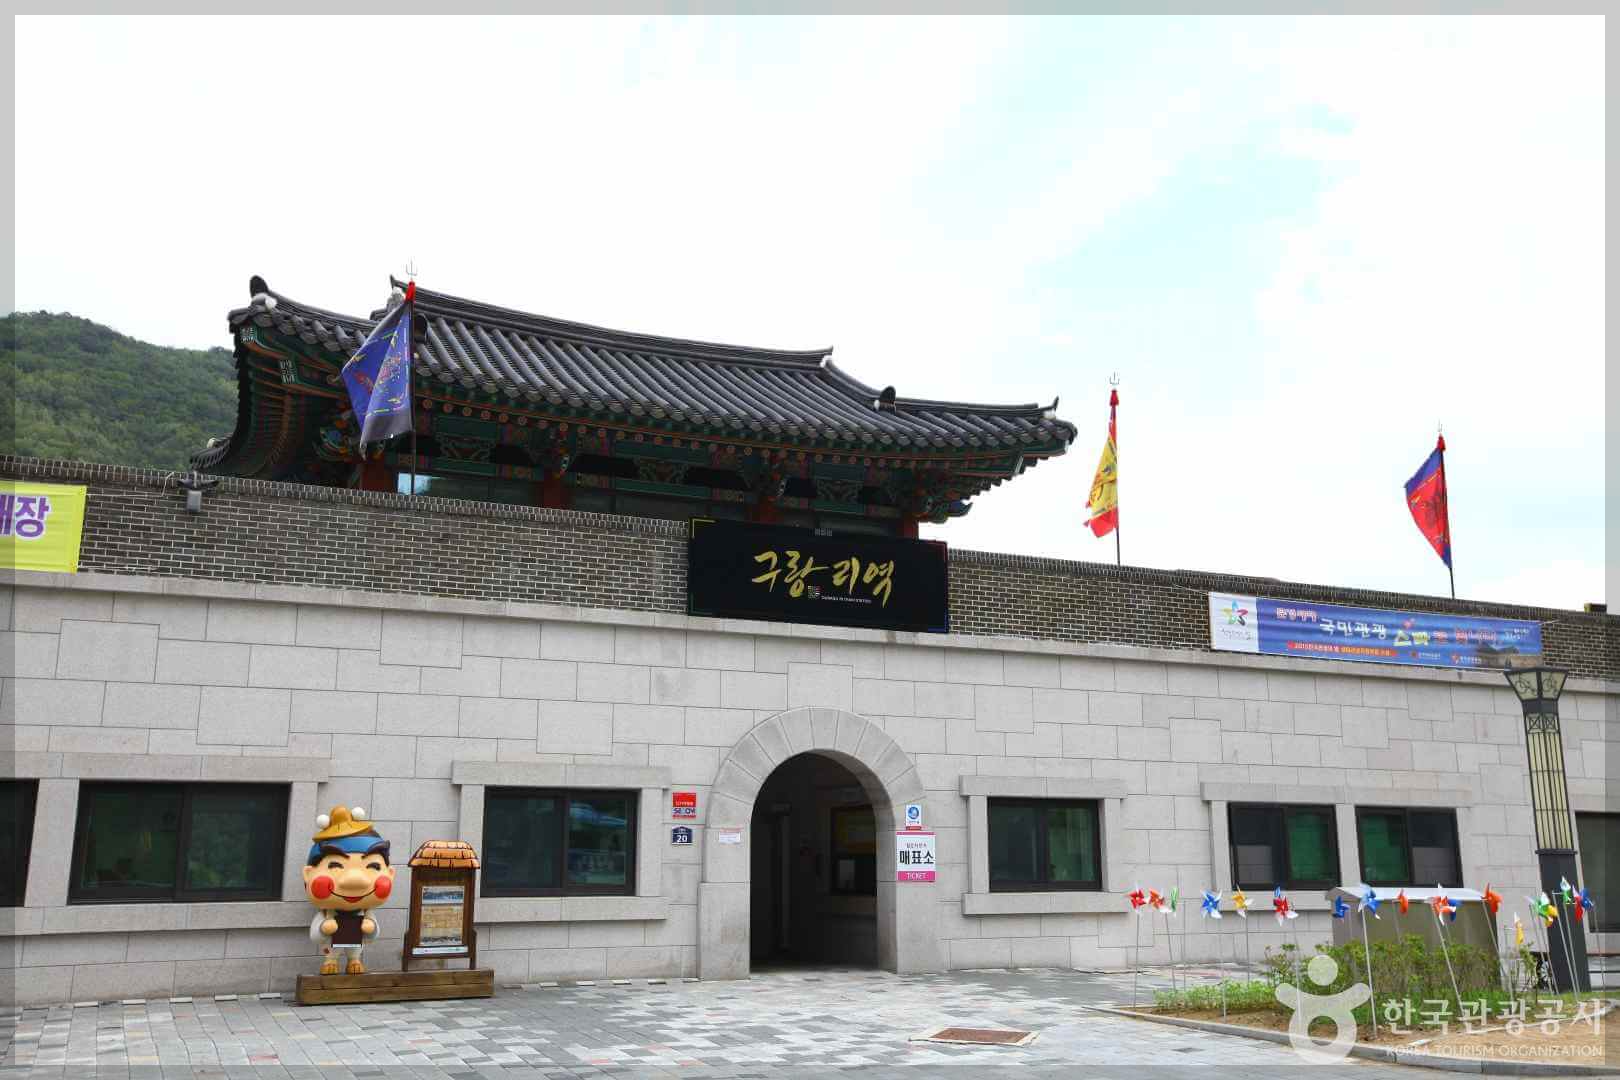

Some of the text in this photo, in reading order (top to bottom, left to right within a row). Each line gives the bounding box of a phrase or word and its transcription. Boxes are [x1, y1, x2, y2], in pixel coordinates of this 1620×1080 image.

[676, 834, 688, 843] 20
[899, 850, 934, 865] 매표소
[904, 872, 928, 880] TICKET
